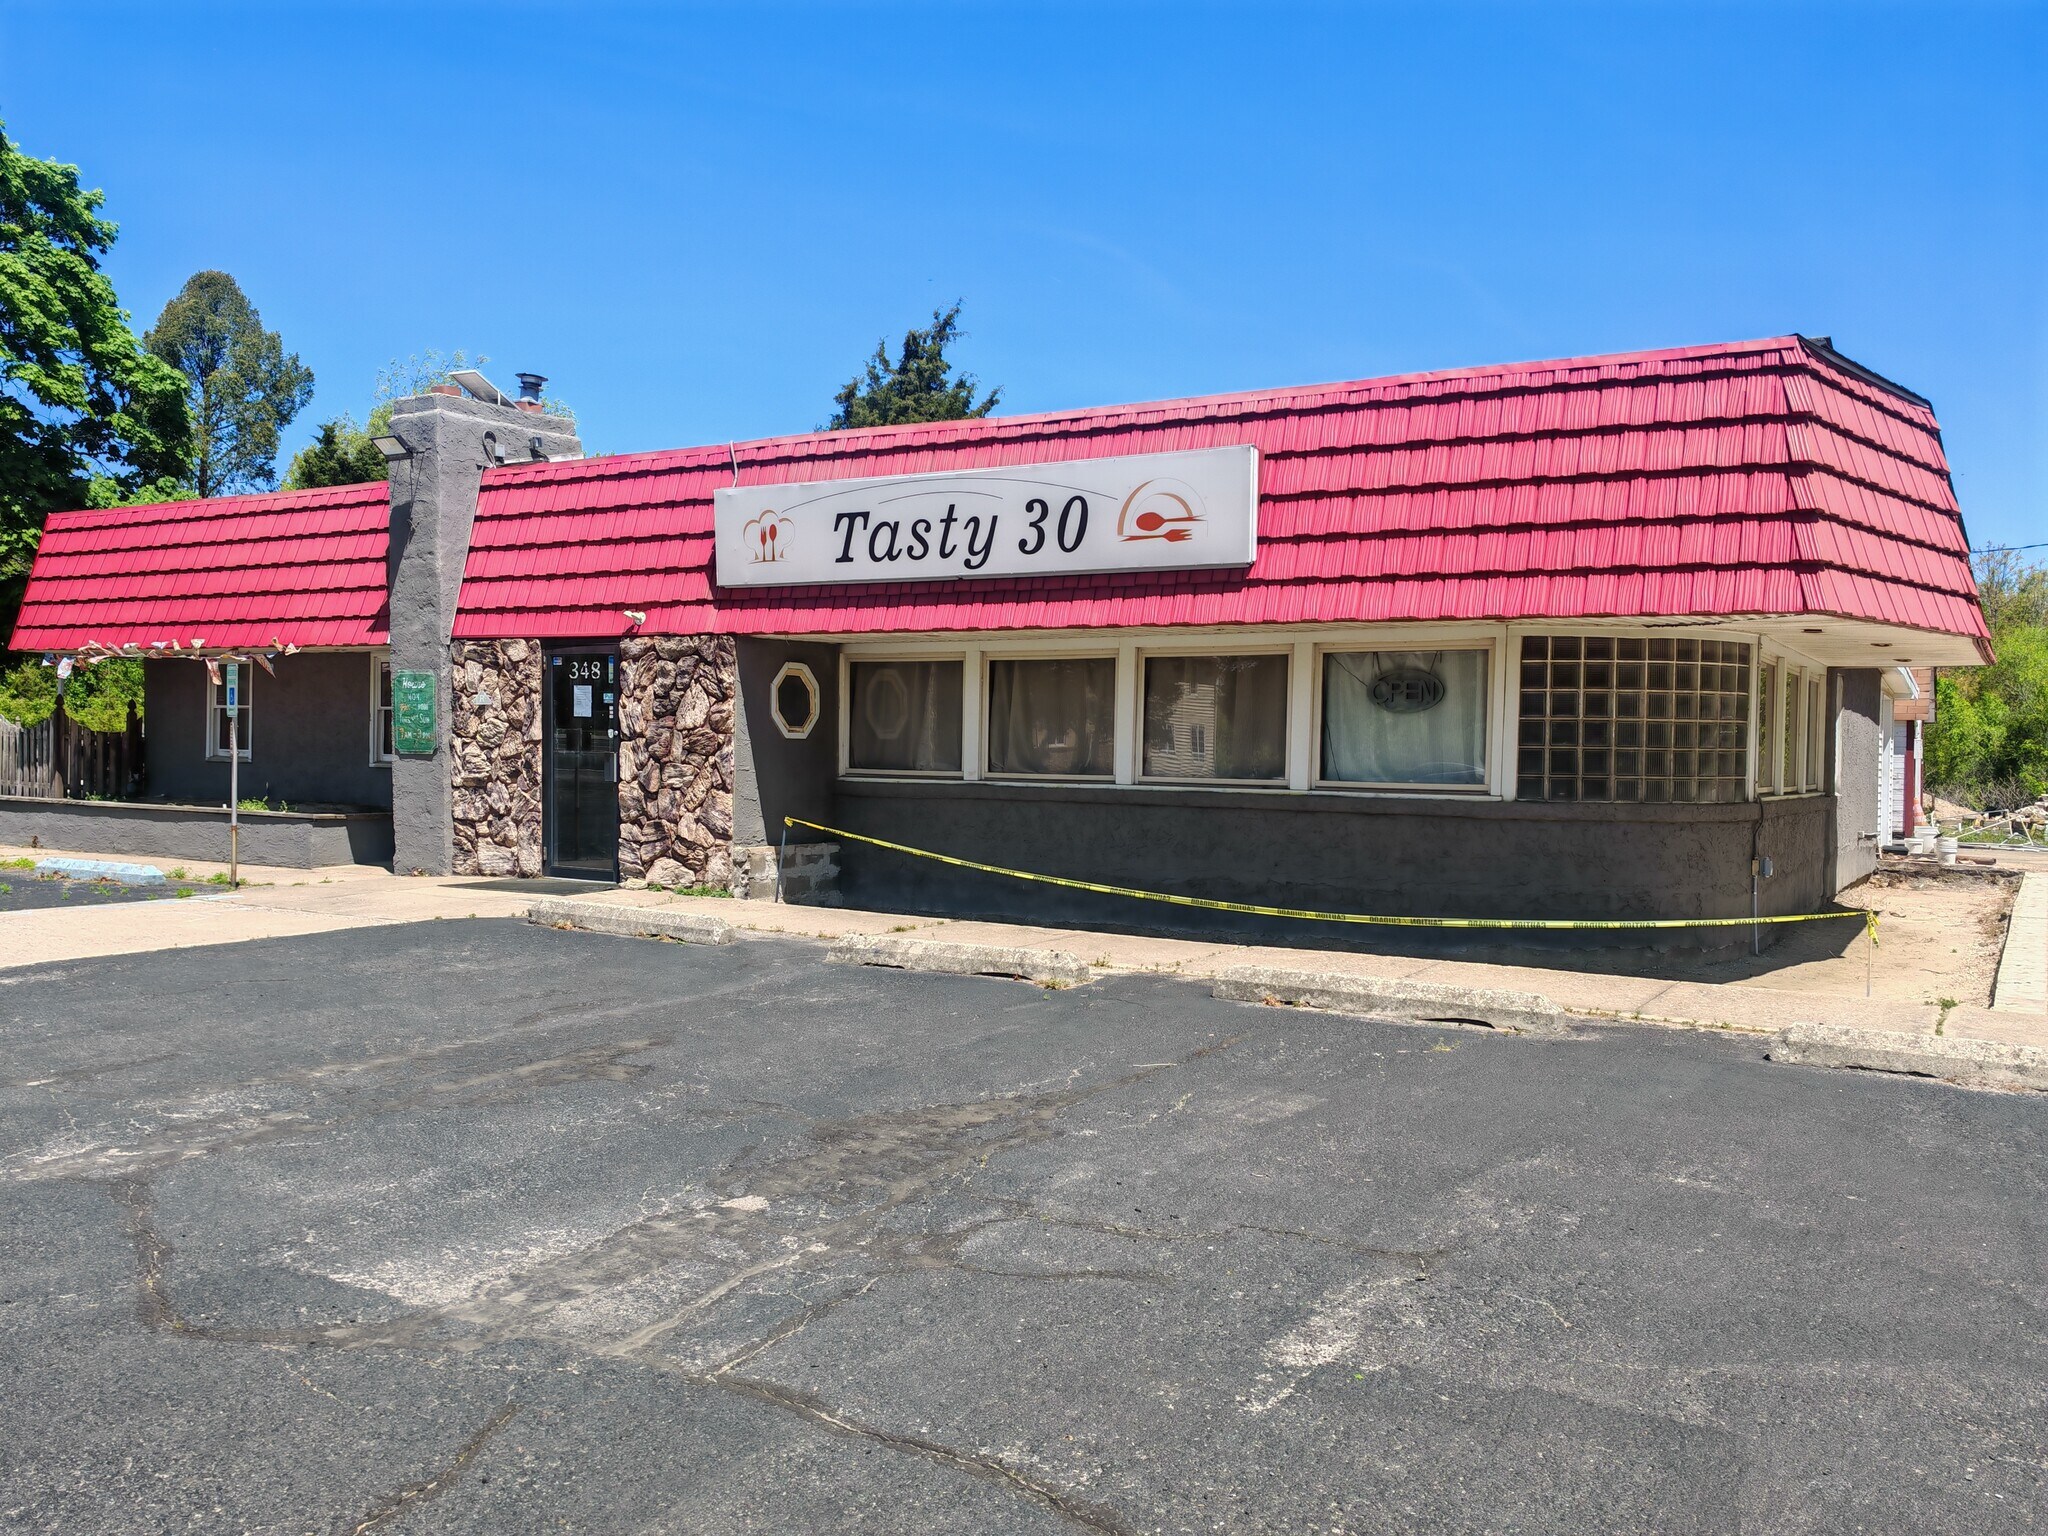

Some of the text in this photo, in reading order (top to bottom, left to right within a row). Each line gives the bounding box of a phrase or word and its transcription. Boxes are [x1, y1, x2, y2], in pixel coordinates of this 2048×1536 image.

[833, 495, 1089, 570] Tasty 30
[568, 661, 601, 679] 348
[1373, 680, 1436, 705] OPEN
